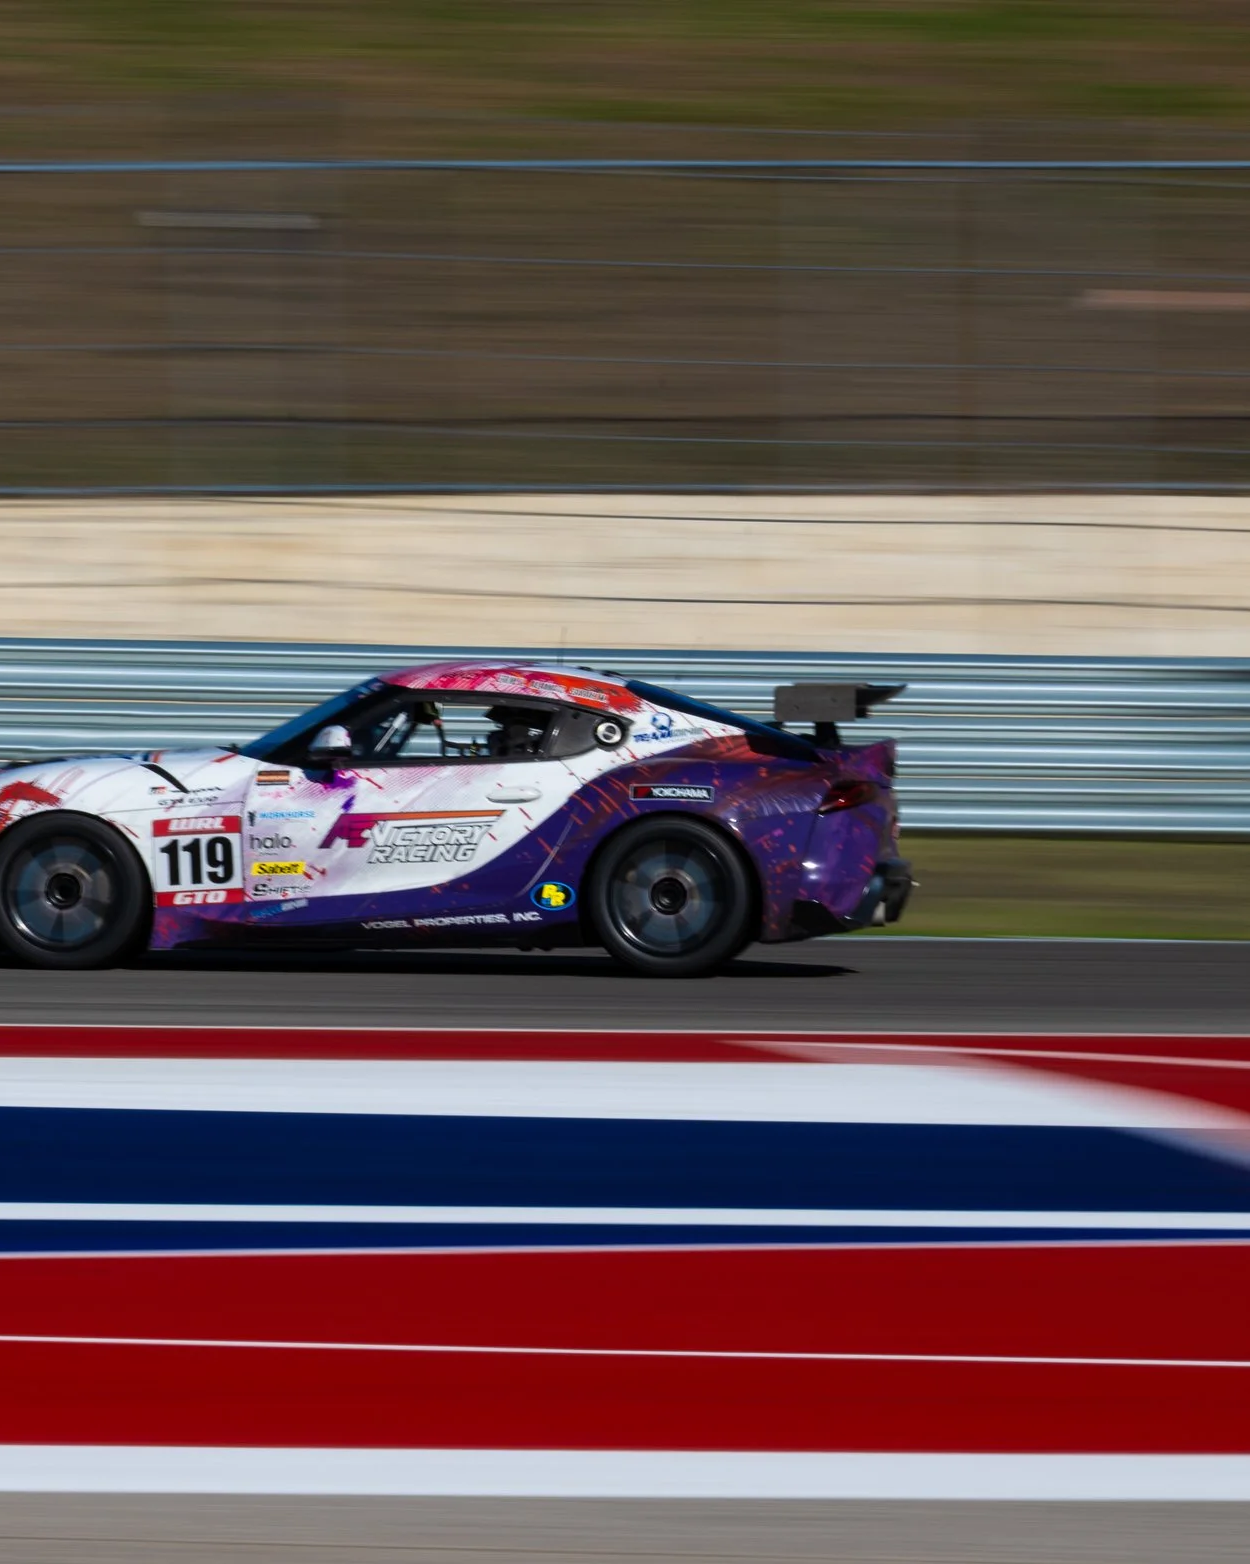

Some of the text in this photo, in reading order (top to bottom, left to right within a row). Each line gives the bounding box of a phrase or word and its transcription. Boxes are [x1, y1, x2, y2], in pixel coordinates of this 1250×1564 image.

[651, 787, 710, 799] YOKOHAMA
[168, 816, 225, 831] WRL
[372, 820, 493, 845] VICTORY
[249, 832, 292, 849] halo
[160, 836, 233, 885] 119
[368, 844, 479, 863] RACING
[258, 863, 300, 874] Sabelt
[361, 911, 543, 930] VOGEL PROPERTIES, INC.
